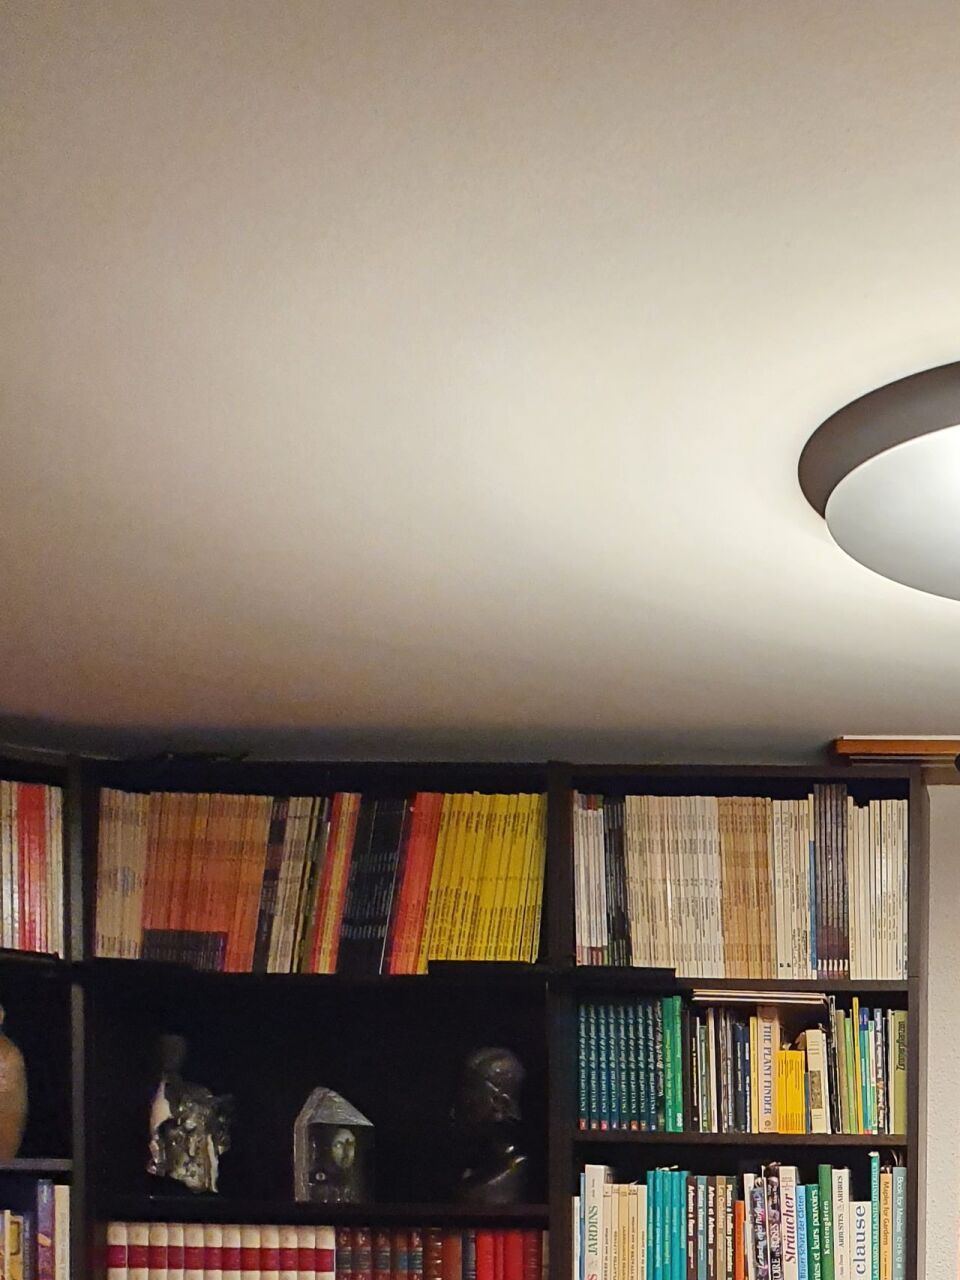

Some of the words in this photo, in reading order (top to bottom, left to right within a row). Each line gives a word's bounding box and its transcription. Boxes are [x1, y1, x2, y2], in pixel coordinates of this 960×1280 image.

[882, 1181, 890, 1205] Maples
[896, 1176, 904, 1194] Book
[811, 1190, 820, 1226] pouvoirs
[882, 1207, 890, 1217] for
[896, 1196, 904, 1206] for
[587, 1205, 598, 1256] JARDINS
[783, 1193, 796, 1263] Sträucher
[823, 1200, 831, 1255] Knotengärten
[882, 1219, 890, 1245] Gardens
[895, 1208, 903, 1232] Maples
[770, 1222, 781, 1248] ROSES
[811, 1229, 820, 1250] leurs
[853, 1205, 866, 1275] clause
[812, 1252, 821, 1260] et
